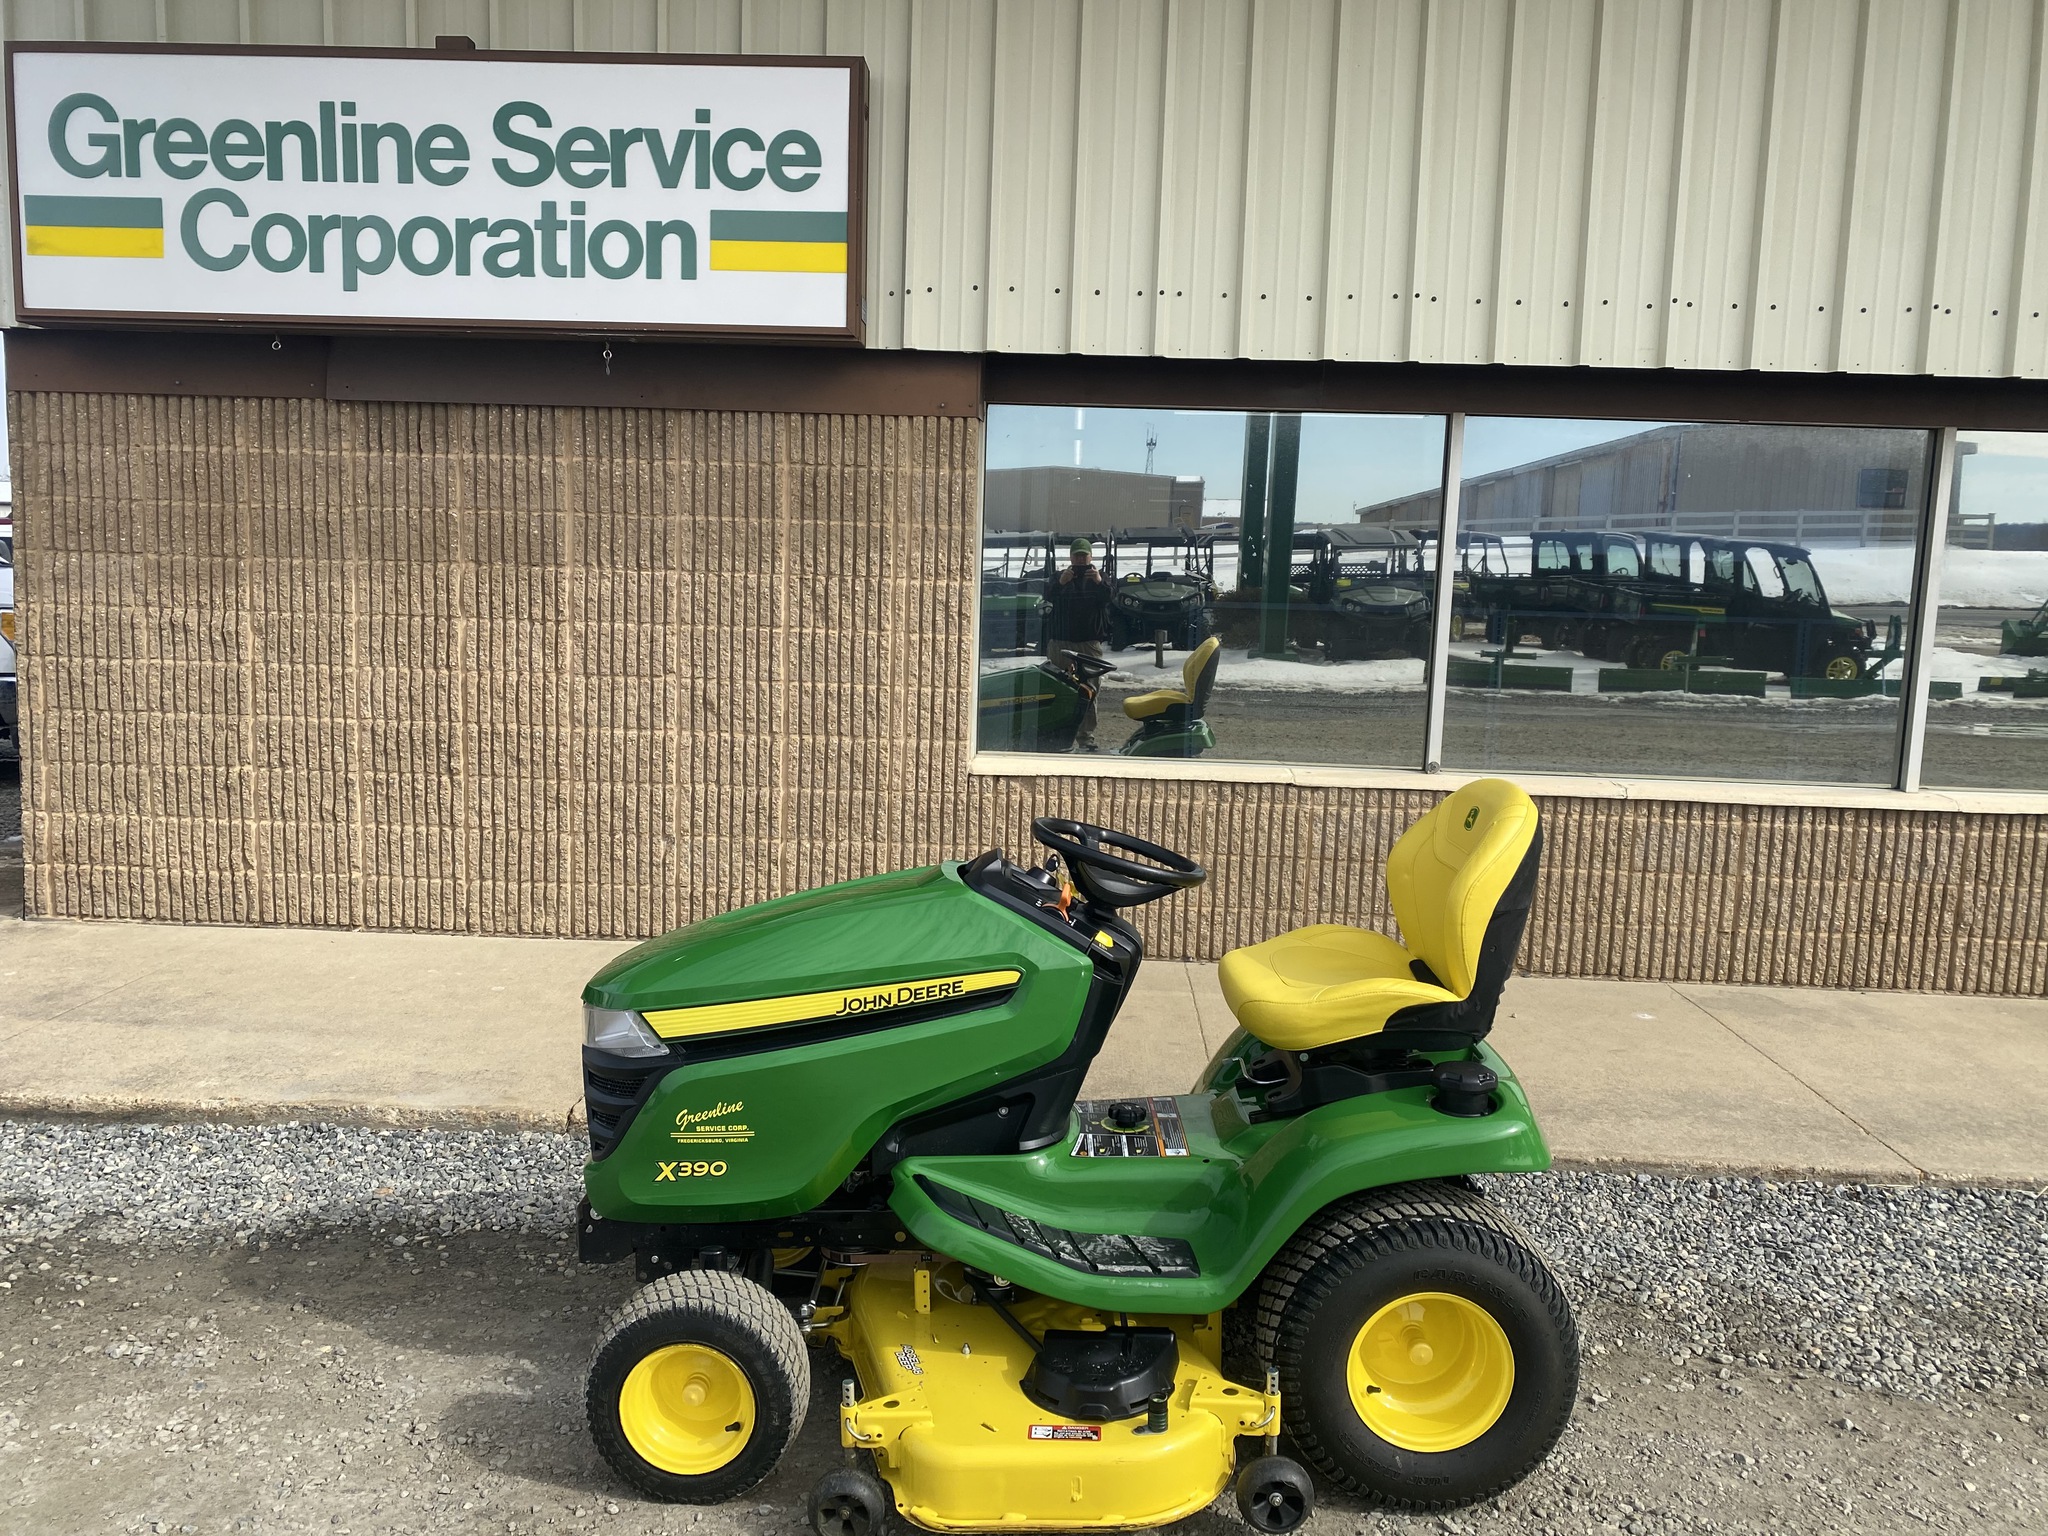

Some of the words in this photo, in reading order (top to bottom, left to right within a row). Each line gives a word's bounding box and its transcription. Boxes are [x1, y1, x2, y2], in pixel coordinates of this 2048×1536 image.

[49, 92, 469, 185] Greenline
[492, 101, 822, 192] Service
[180, 187, 698, 292] Corporation
[836, 992, 892, 1015] JOHN
[898, 979, 964, 1005] DEERE
[675, 1101, 744, 1132] Greenline
[653, 1160, 728, 1182] X390
[1413, 1267, 1530, 1322] CARLISLE
[894, 1351, 914, 1371] DEEP
